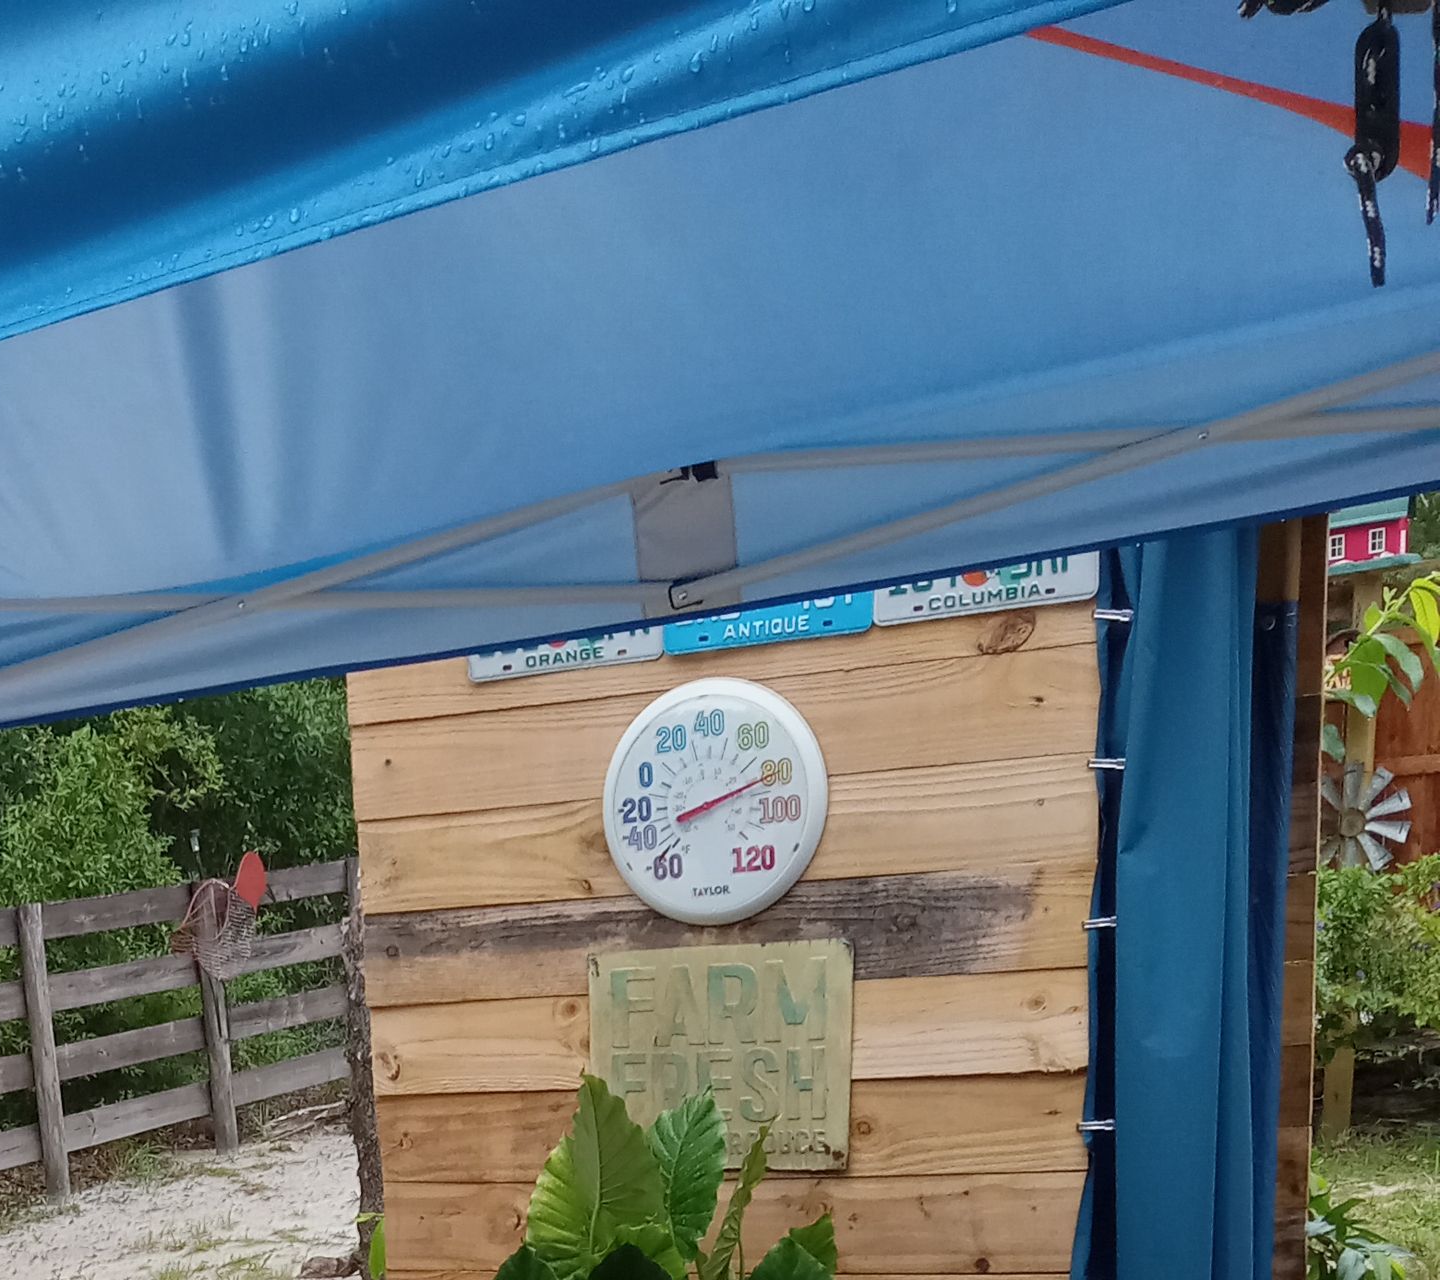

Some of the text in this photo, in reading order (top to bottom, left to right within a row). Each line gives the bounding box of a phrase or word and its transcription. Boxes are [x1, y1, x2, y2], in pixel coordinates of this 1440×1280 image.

[928, 583, 1042, 612] COLUMBIA
[722, 614, 811, 641] ANTIQUE
[525, 646, 605, 668] ORANGE
[694, 708, 726, 737] 40
[737, 720, 770, 751] 60
[656, 723, 687, 753] 20
[638, 760, 653, 788] 0
[760, 757, 793, 787] 80
[759, 794, 801, 824] 100
[731, 844, 776, 874] 120
[692, 884, 731, 897] TAYLOR
[610, 956, 829, 1048] FARM
